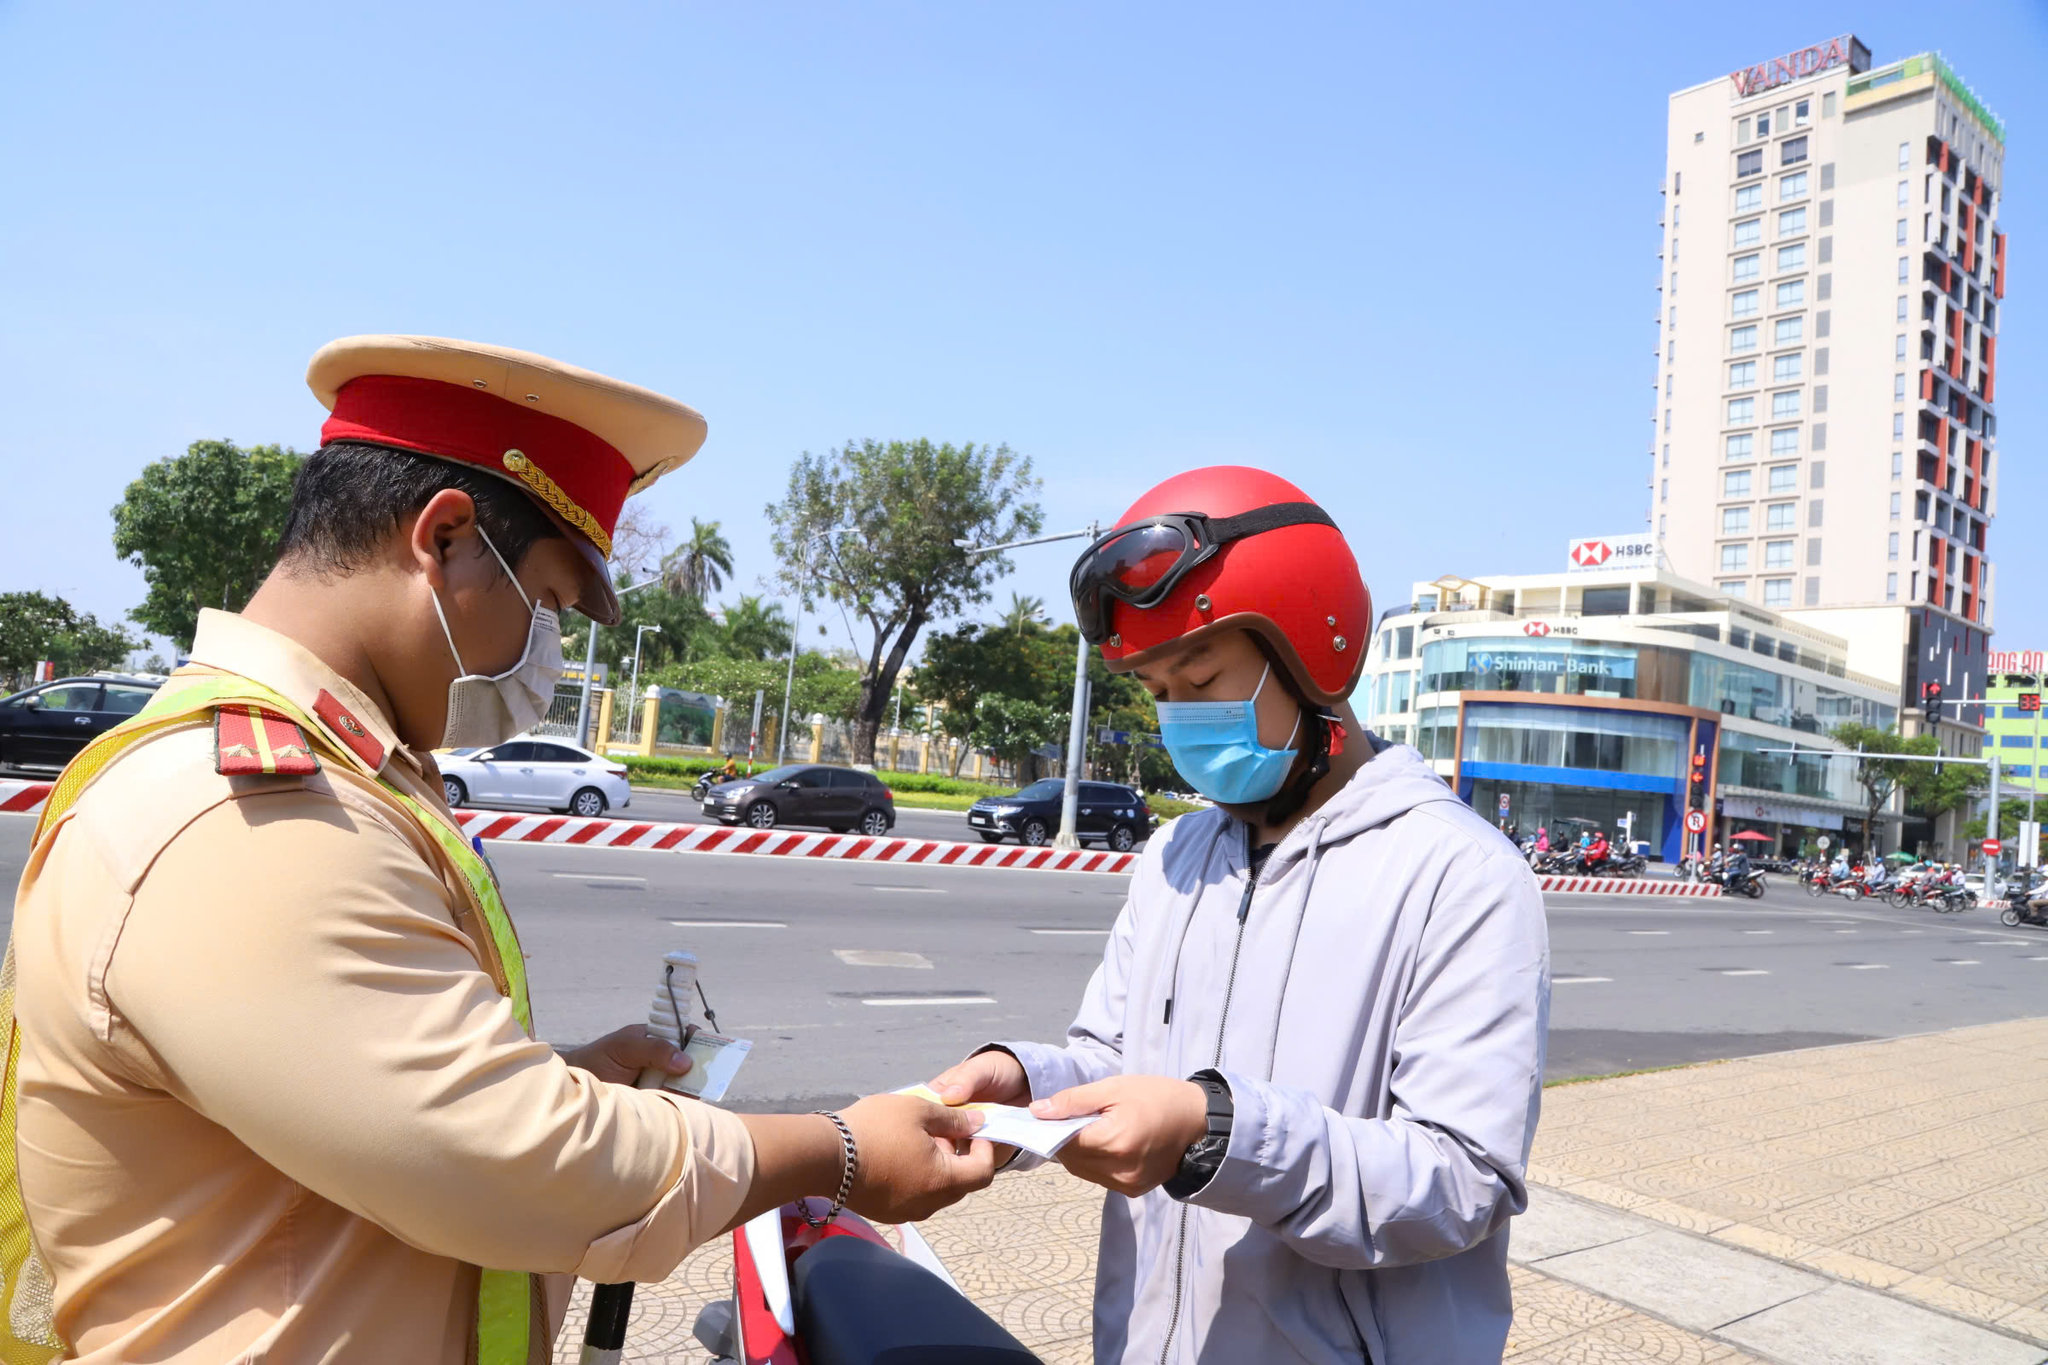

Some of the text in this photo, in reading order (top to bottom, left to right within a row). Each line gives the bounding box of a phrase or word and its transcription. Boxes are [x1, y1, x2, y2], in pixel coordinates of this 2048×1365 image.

[1730, 38, 1848, 97] VANDA
[1616, 543, 1653, 557] HSBC
[1553, 626, 1578, 635] HSBC
[1494, 656, 1609, 675] Shinhan Bank
[2020, 694, 2040, 710] 33
